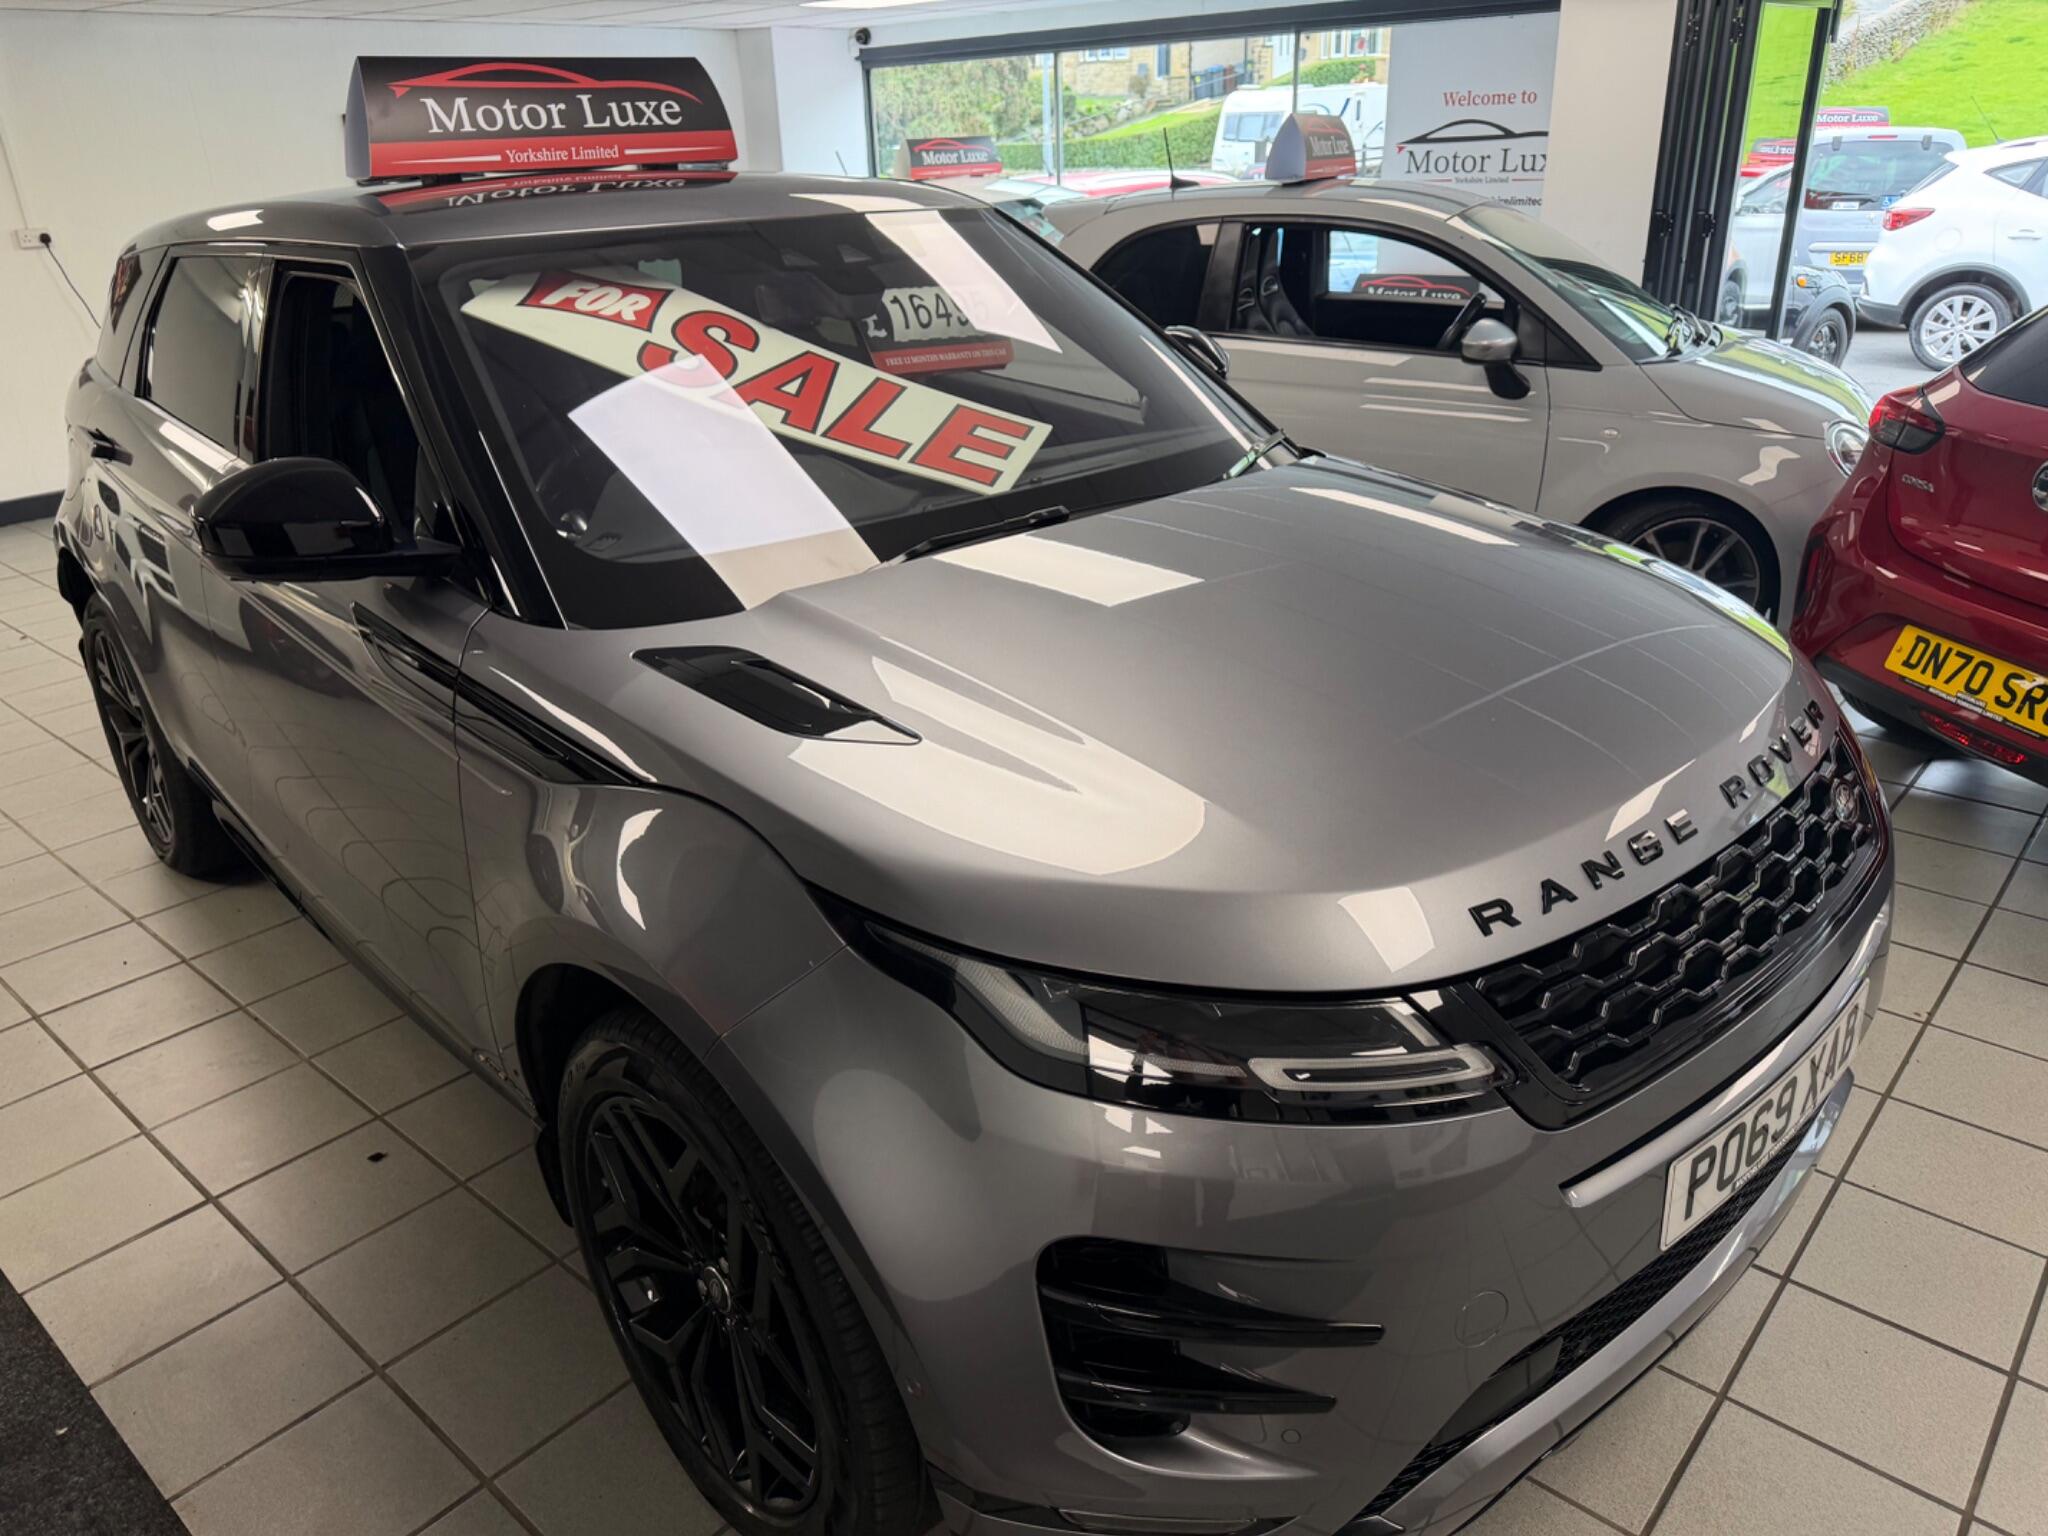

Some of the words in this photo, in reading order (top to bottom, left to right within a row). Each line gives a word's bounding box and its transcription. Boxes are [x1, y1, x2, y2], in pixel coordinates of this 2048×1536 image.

[420, 96, 567, 134] Motor
[576, 94, 683, 128] Luxe
[1443, 90, 1517, 107] Welcome
[1521, 89, 1538, 105] to
[505, 148, 569, 164] Yorkshire
[571, 145, 620, 161] Limited
[921, 150, 959, 166] Motor
[960, 149, 989, 163] Luxe
[1405, 150, 1492, 175] Motor
[544, 280, 652, 322] FOR
[636, 310, 1035, 489] SALE
[1901, 634, 1995, 696] DN70
[1994, 672, 2048, 727] SR
[1468, 808, 1699, 937] RANGE
[1719, 699, 1825, 809] ROVER
[1683, 1075, 1798, 1221] PO69
